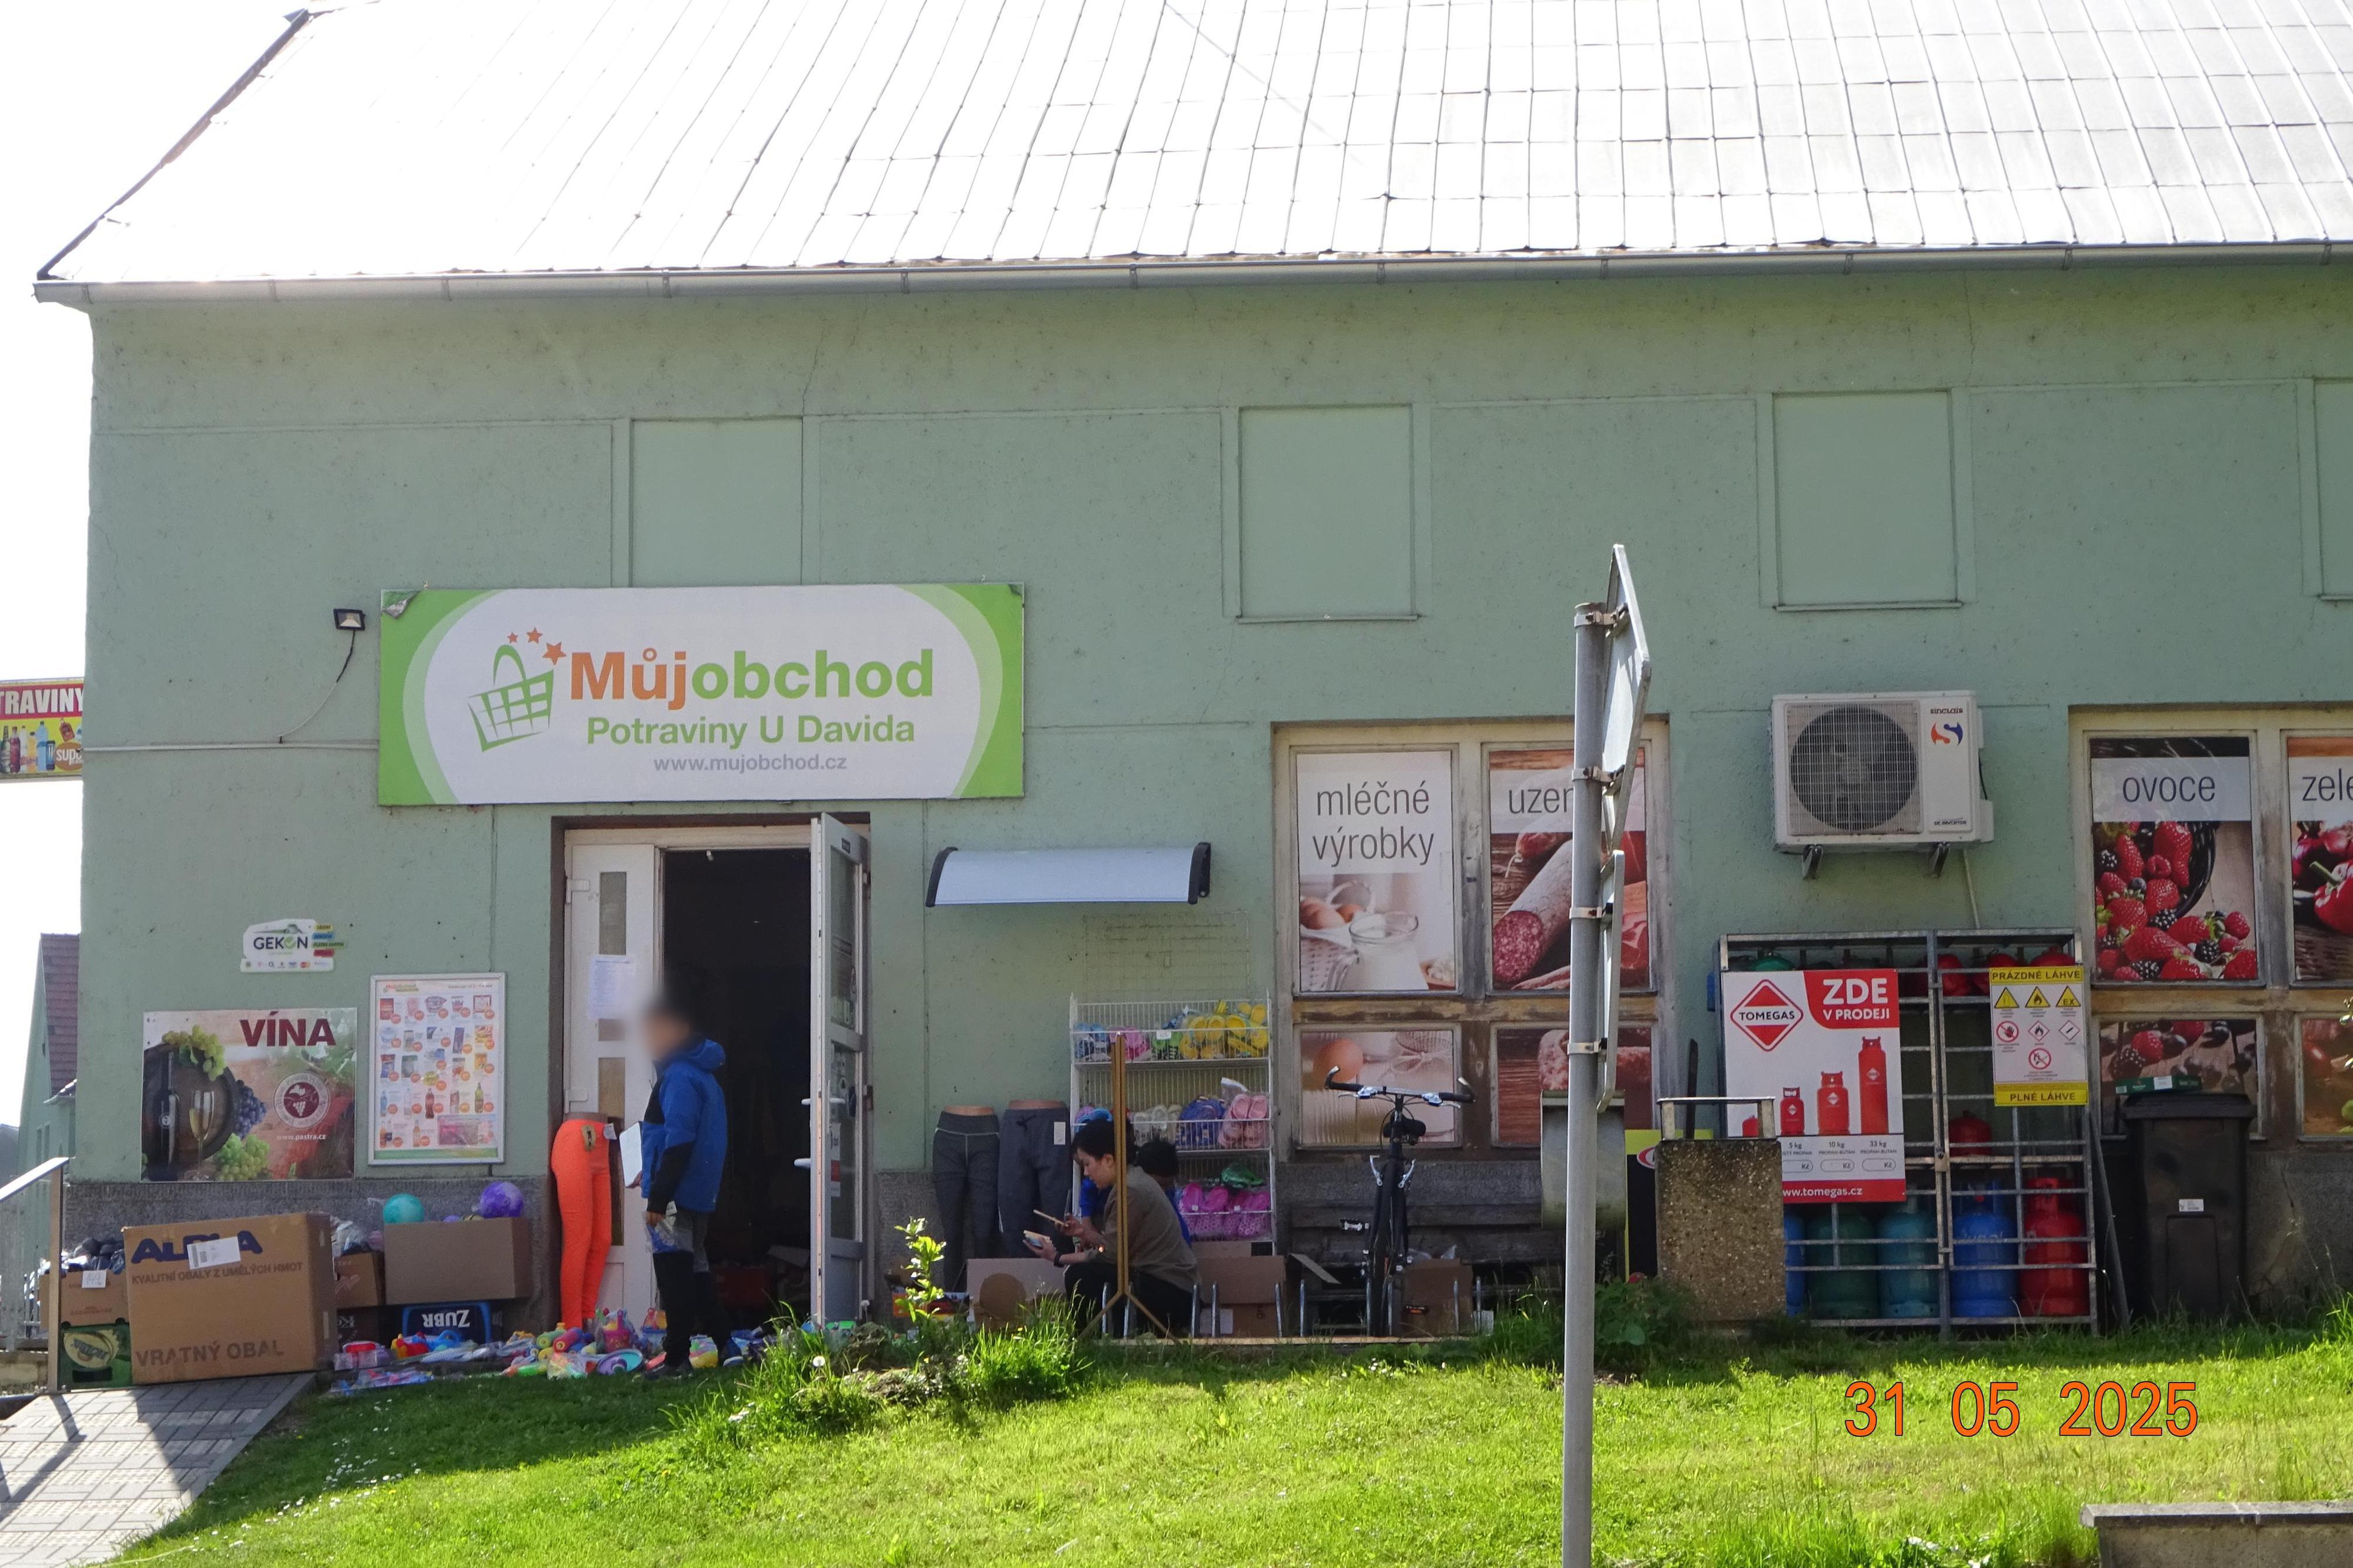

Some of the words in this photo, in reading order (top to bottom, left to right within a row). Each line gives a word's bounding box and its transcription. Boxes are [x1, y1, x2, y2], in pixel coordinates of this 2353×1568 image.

[571, 648, 933, 710] Můjobchod
[587, 716, 748, 750] Potraviny
[759, 715, 784, 744] U
[798, 715, 915, 743] Davida
[653, 753, 848, 774] www.mujobchod.cz
[1317, 780, 1430, 816] mléčné
[1508, 788, 1574, 814] uzen
[2122, 776, 2215, 802] ovoce
[1312, 826, 1435, 867] výrobky
[1992, 970, 2042, 980] PRÁZDNÉ
[2045, 969, 2081, 979] LÁHVE
[1822, 978, 1889, 1006] ZDE
[1739, 1010, 1795, 1021] TOMEGAS
[1822, 1009, 1832, 1021] V
[1835, 1008, 1889, 1020] PRODEJI
[239, 1010, 337, 1047] VÍNA
[2009, 1092, 2038, 1102] PLNÉ
[2041, 1091, 2076, 1101] LÁHVE
[276, 1133, 326, 1142] www.pastra.cz
[1782, 1187, 1863, 1198] ww.tomegas.cz
[131, 1230, 264, 1265] ALPA
[132, 1270, 176, 1284] KVALITNÍ
[213, 1270, 220, 1278] Z
[222, 1263, 271, 1277] UMĚLÝCH
[421, 1309, 471, 1328] ZUBR
[135, 1340, 221, 1367] VRATNÝ
[226, 1339, 285, 1360] OBAL
